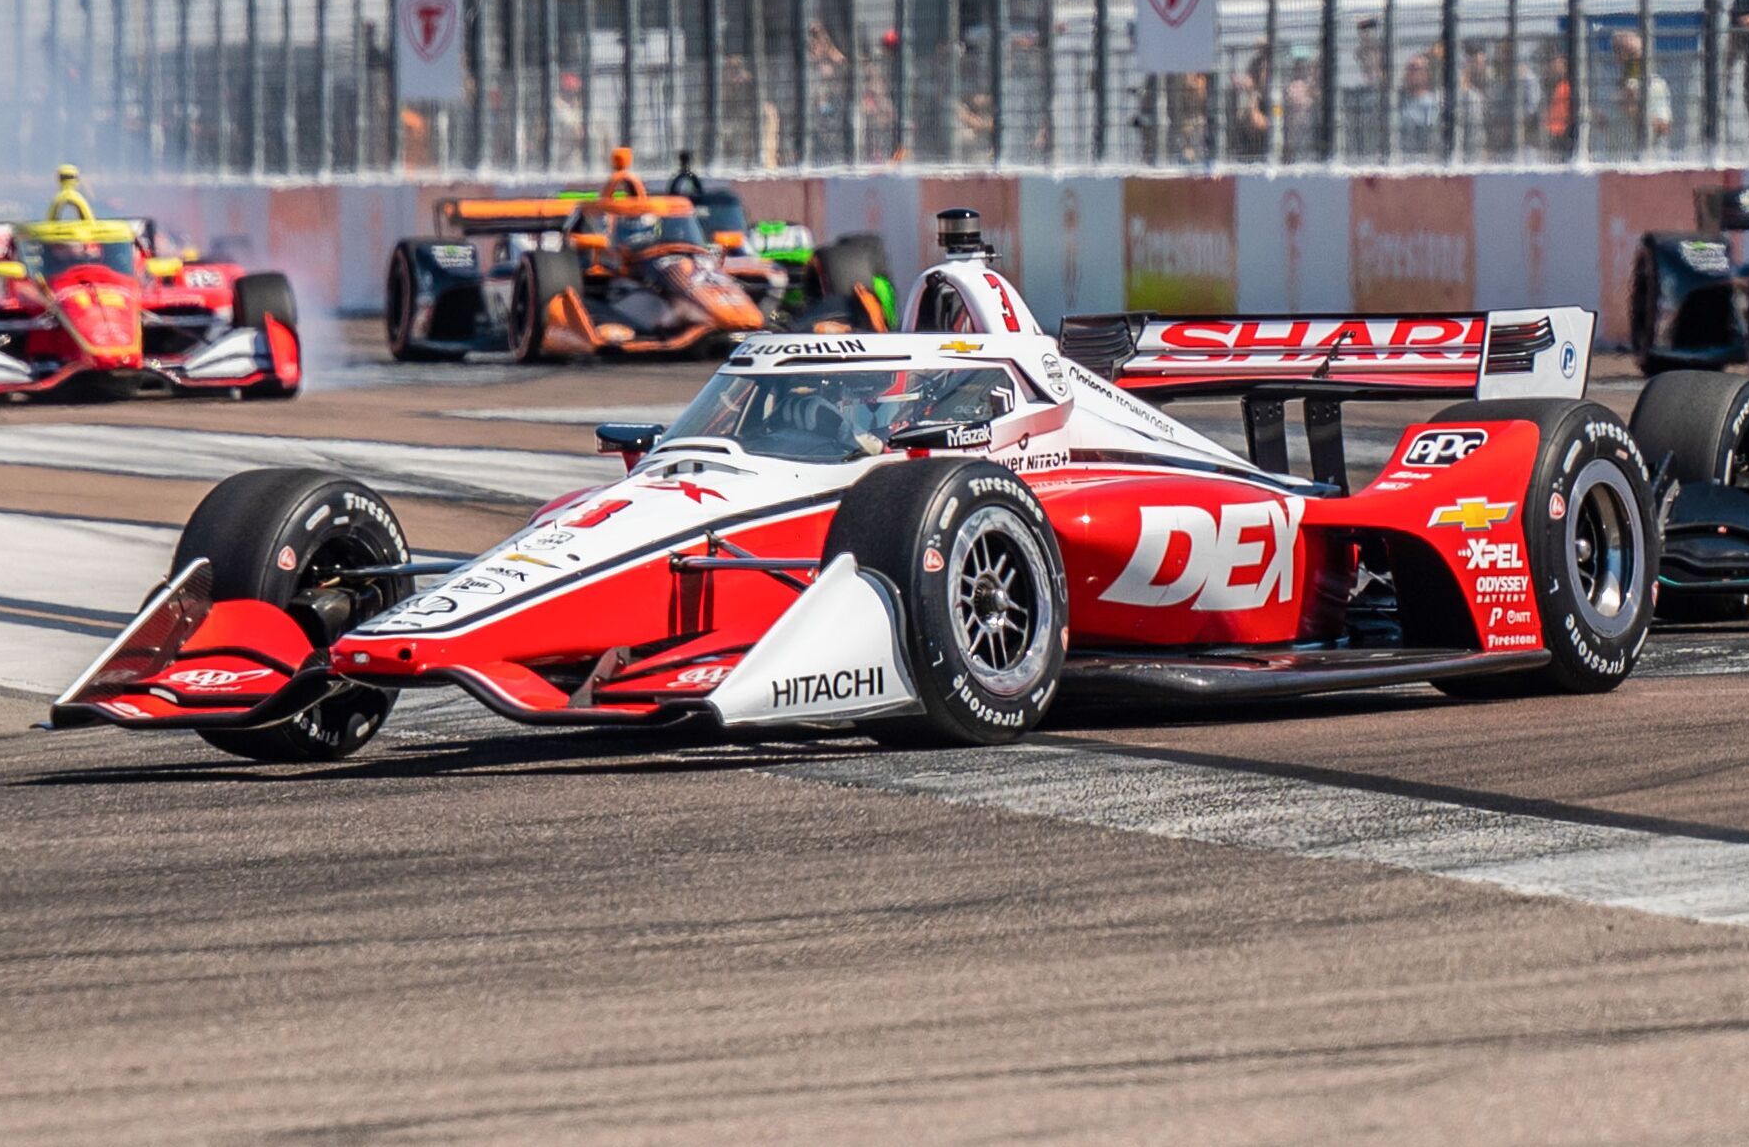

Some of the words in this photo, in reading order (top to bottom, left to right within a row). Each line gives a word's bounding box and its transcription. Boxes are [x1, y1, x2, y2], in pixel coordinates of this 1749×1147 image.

[982, 273, 1021, 333] 3
[946, 424, 992, 447] Mazak
[1409, 434, 1482, 464] PPG
[1584, 421, 1649, 482] Firestone
[967, 476, 1044, 522] Firestone
[342, 492, 409, 563] Firestone
[1098, 496, 1306, 613] DEX
[1466, 538, 1524, 569] XPEL
[1476, 576, 1529, 593] ODYSSEY
[1476, 594, 1527, 603] BATTERY
[1487, 634, 1537, 648] Firestone
[1565, 613, 1626, 675] Firestone
[771, 666, 885, 708] HITACHI
[953, 674, 1025, 727] Firestone
